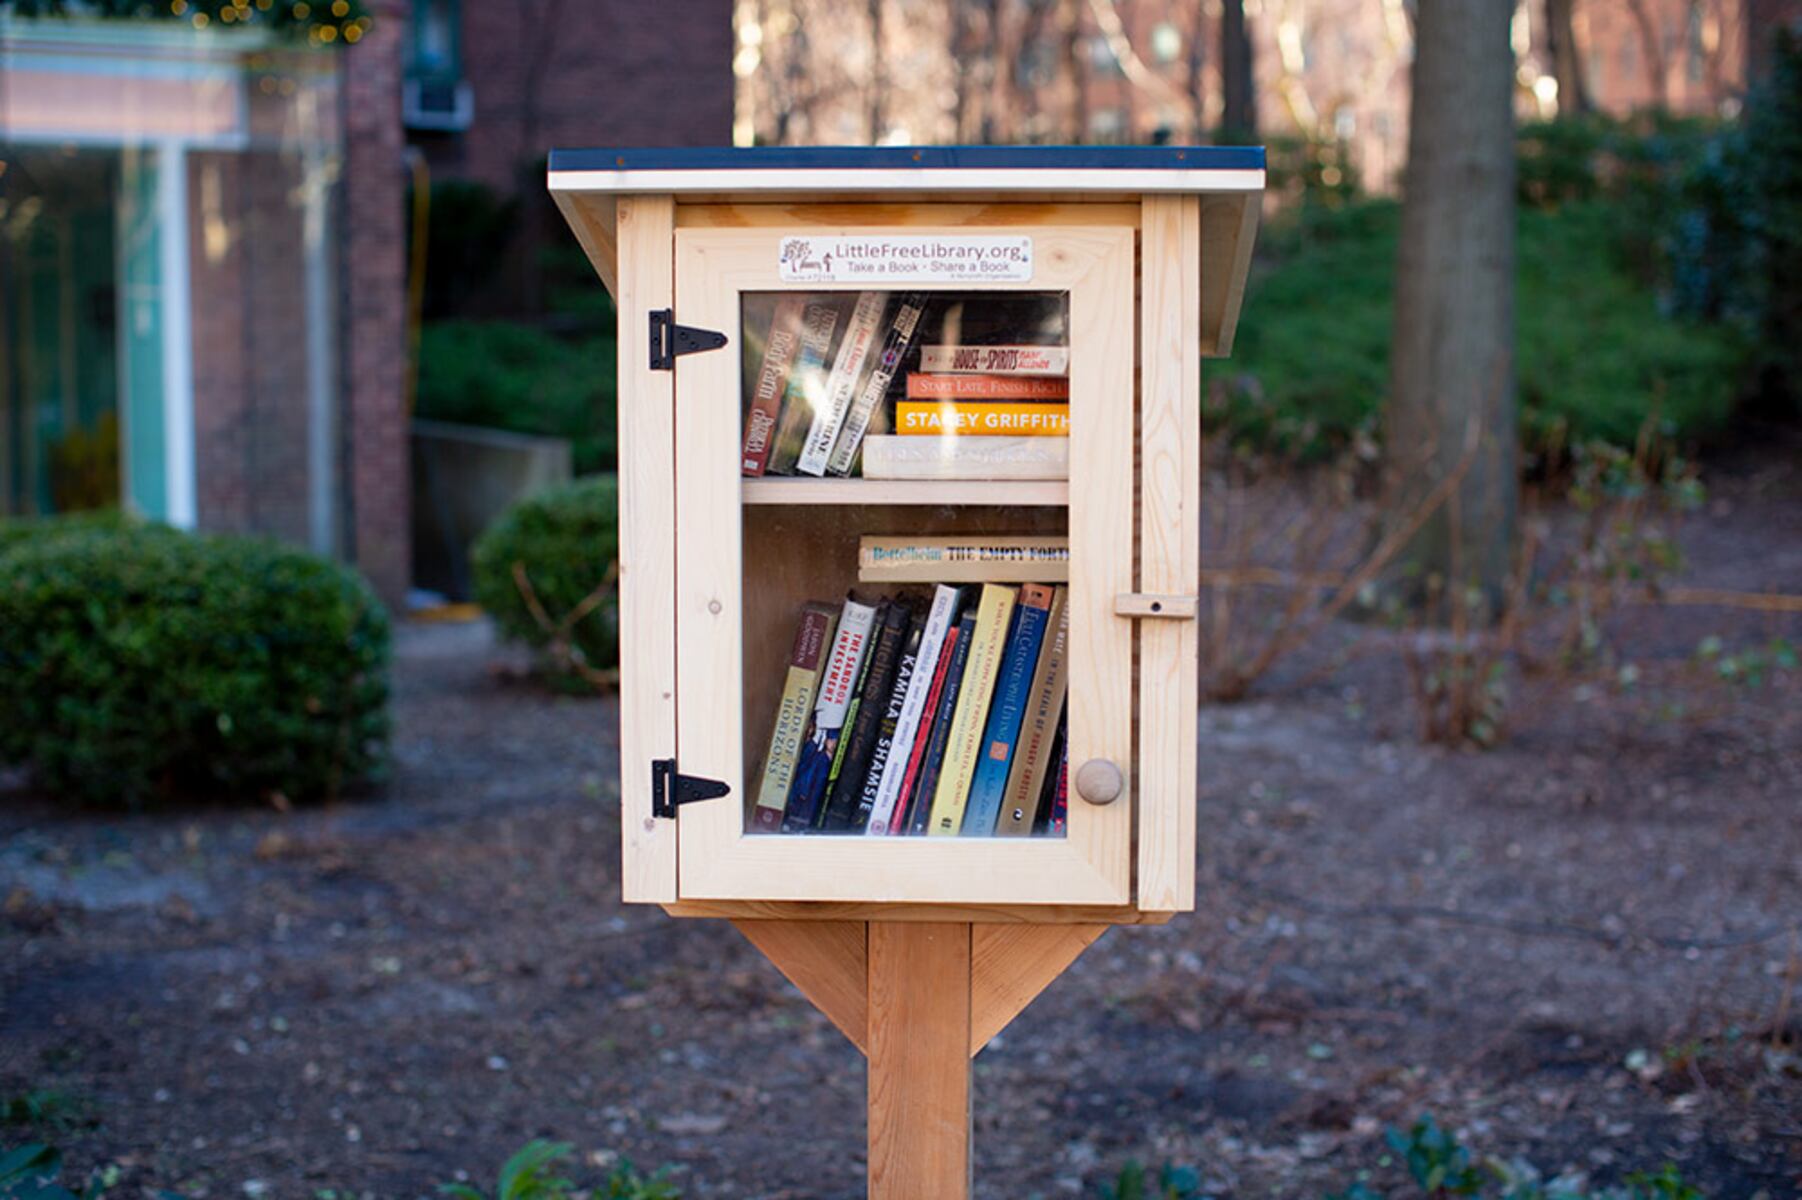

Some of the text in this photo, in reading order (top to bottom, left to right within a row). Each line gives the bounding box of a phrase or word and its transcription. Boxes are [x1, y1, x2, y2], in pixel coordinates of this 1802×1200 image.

[836, 243, 1021, 261] LittleFreeLibrary.org
[848, 260, 1010, 273] Take a Book Share a Book
[758, 328, 792, 401] Body Farm
[921, 380, 952, 393] START
[990, 380, 1029, 393] FINISH
[906, 412, 979, 428] STAEY
[947, 546, 975, 561] THE
[979, 546, 1025, 561] EMPTY
[806, 627, 820, 656] JASON
[849, 632, 863, 653] THE
[821, 629, 852, 702] INVESTMENT
[833, 655, 856, 705] SANDBOX
[884, 653, 916, 720] KAMILA
[766, 697, 795, 776] HORIZONS
[775, 686, 809, 790] LORDS OF THE
[857, 737, 891, 811] SHAMSIE
